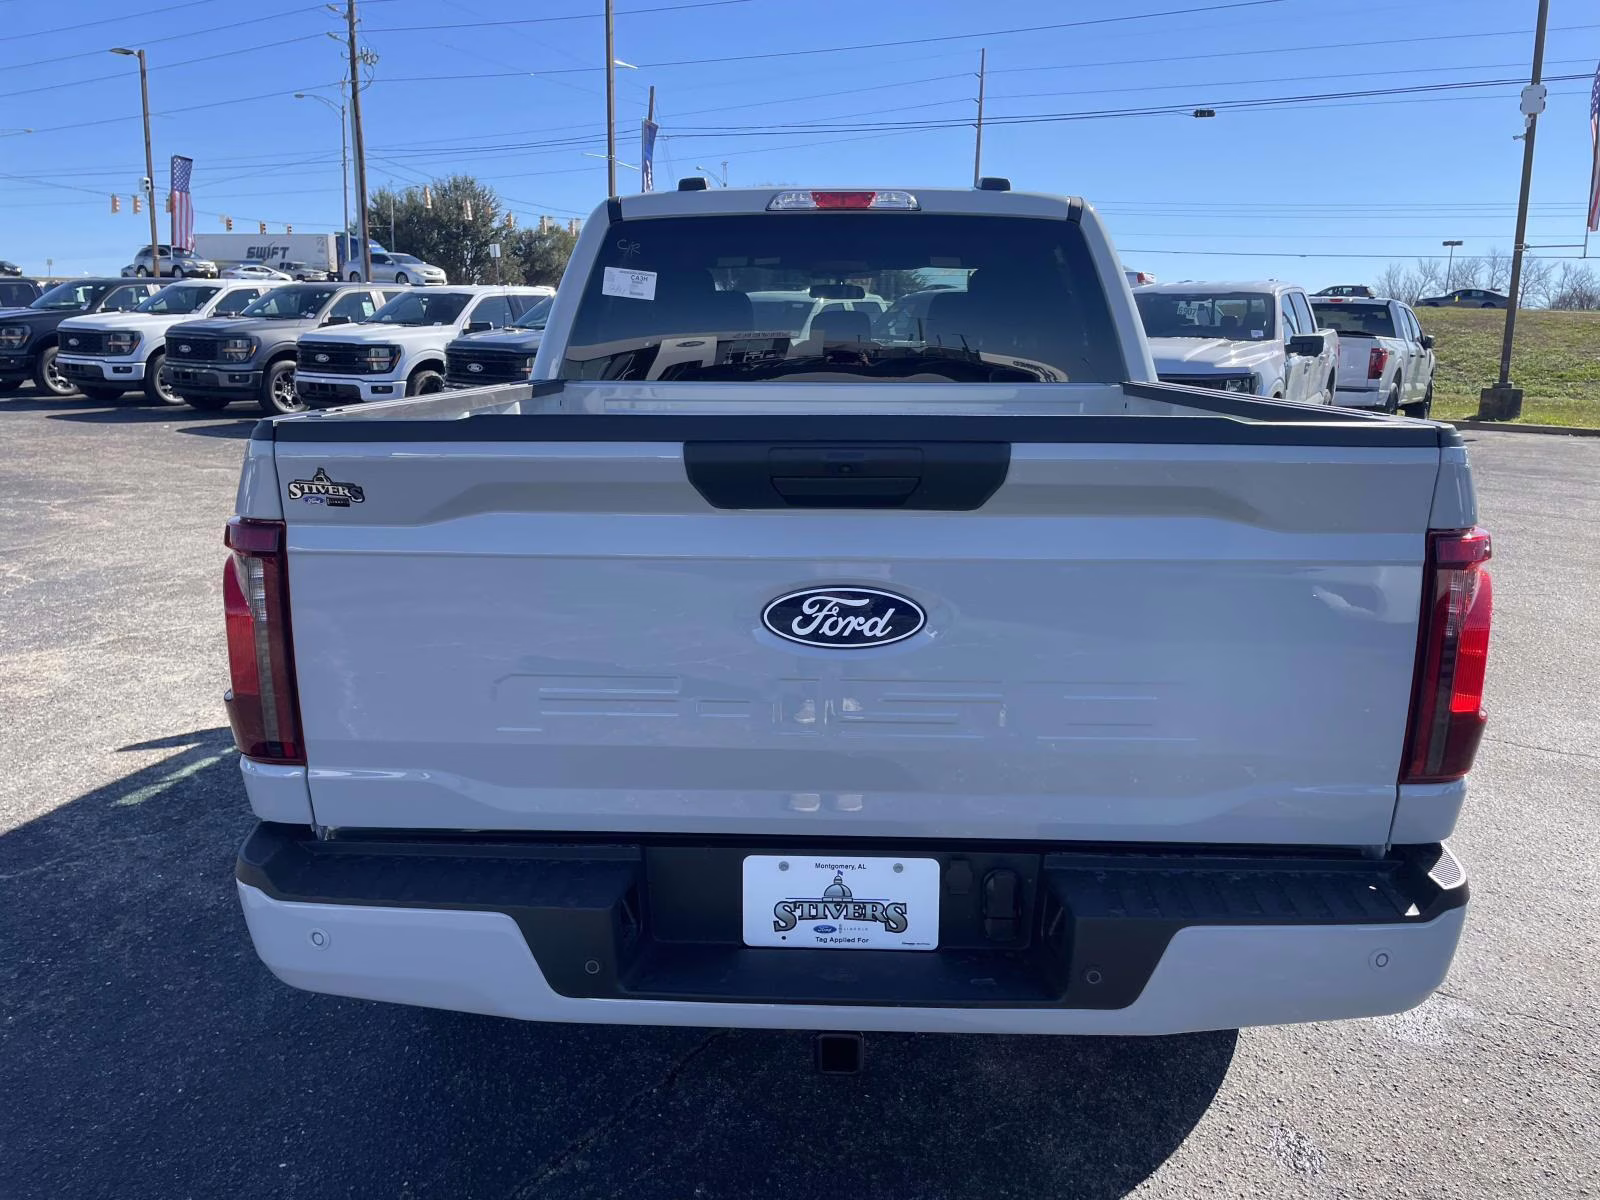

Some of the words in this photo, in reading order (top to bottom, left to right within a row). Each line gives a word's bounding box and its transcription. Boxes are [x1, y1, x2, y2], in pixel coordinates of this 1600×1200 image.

[246, 243, 290, 260] SWIFT
[288, 483, 364, 502] STIVERS
[791, 595, 893, 637] Ford
[815, 862, 856, 870] Montgomery,
[773, 900, 909, 934] STIVERS
